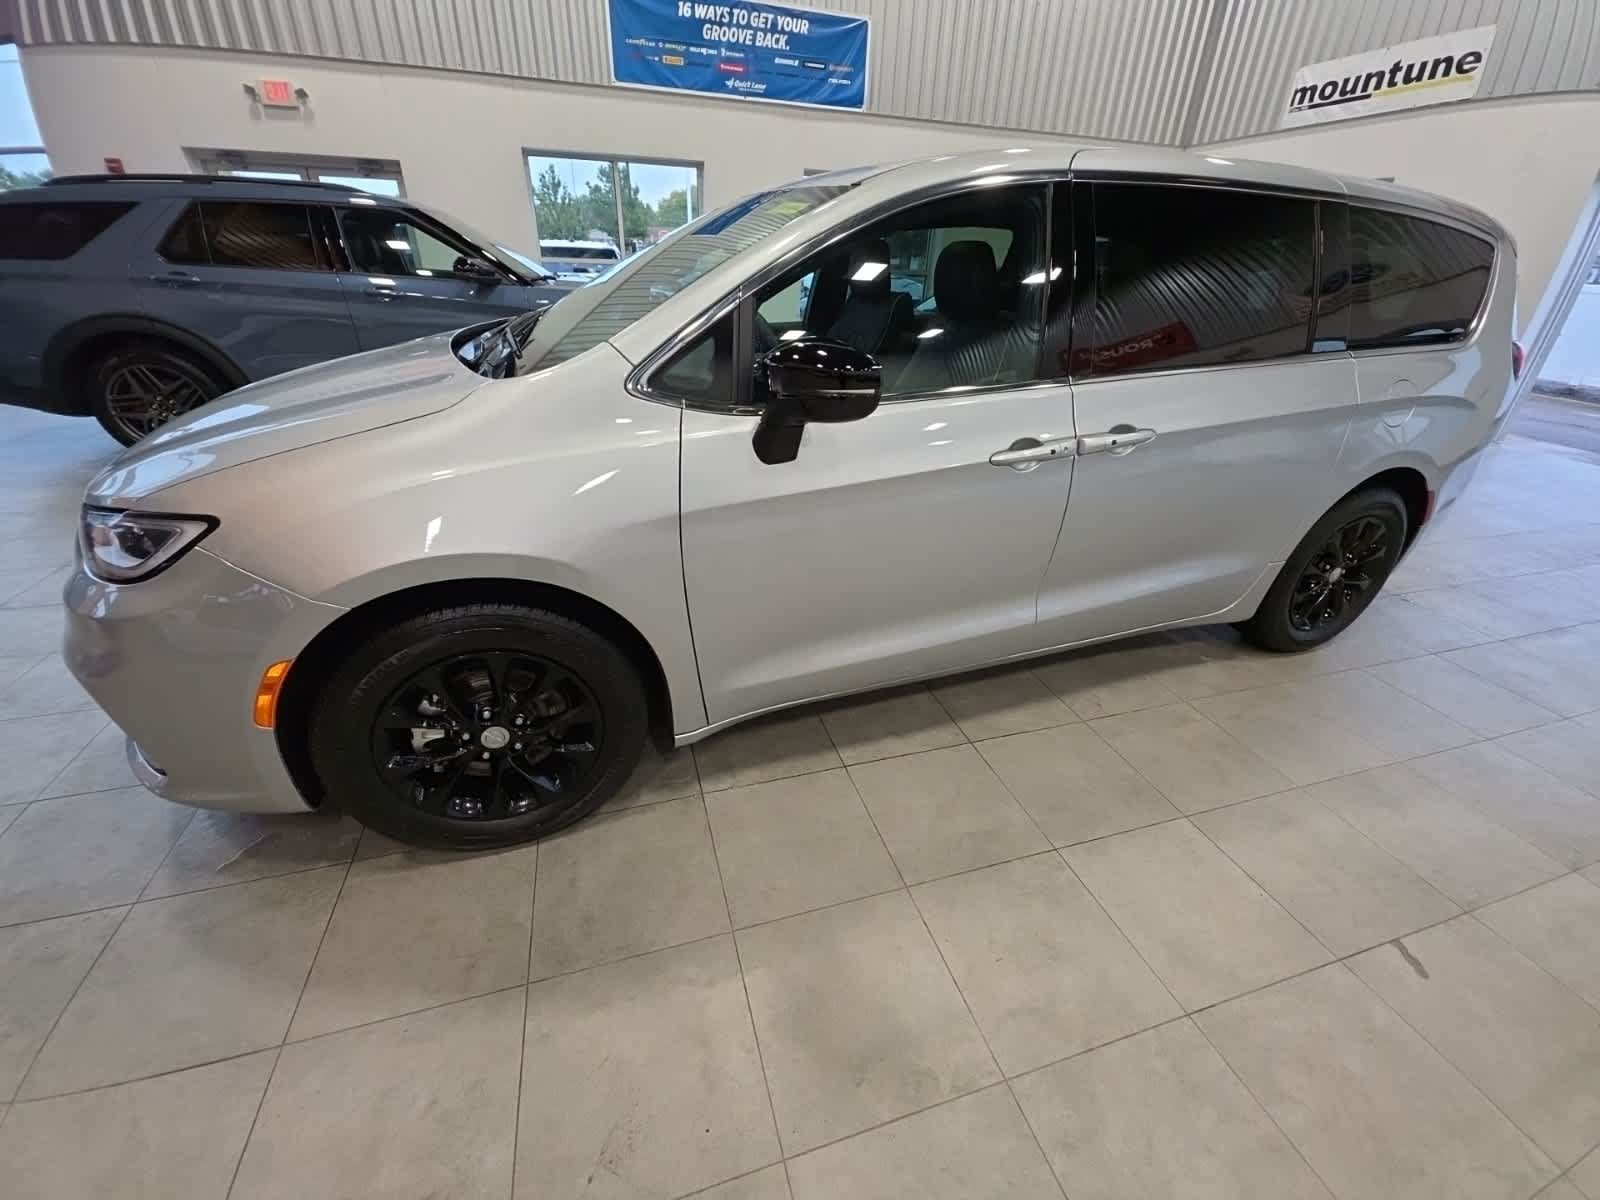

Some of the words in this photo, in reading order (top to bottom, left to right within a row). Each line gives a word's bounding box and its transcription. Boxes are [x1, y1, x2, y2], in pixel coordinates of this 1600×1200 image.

[678, 1, 692, 17] 16
[694, 3, 730, 23] WAYS
[732, 8, 748, 25] TO
[750, 11, 774, 29] GET
[777, 15, 809, 35] YOUR
[703, 23, 753, 45] GROOVE
[755, 31, 790, 50] BACK.
[1290, 50, 1483, 107] mountune
